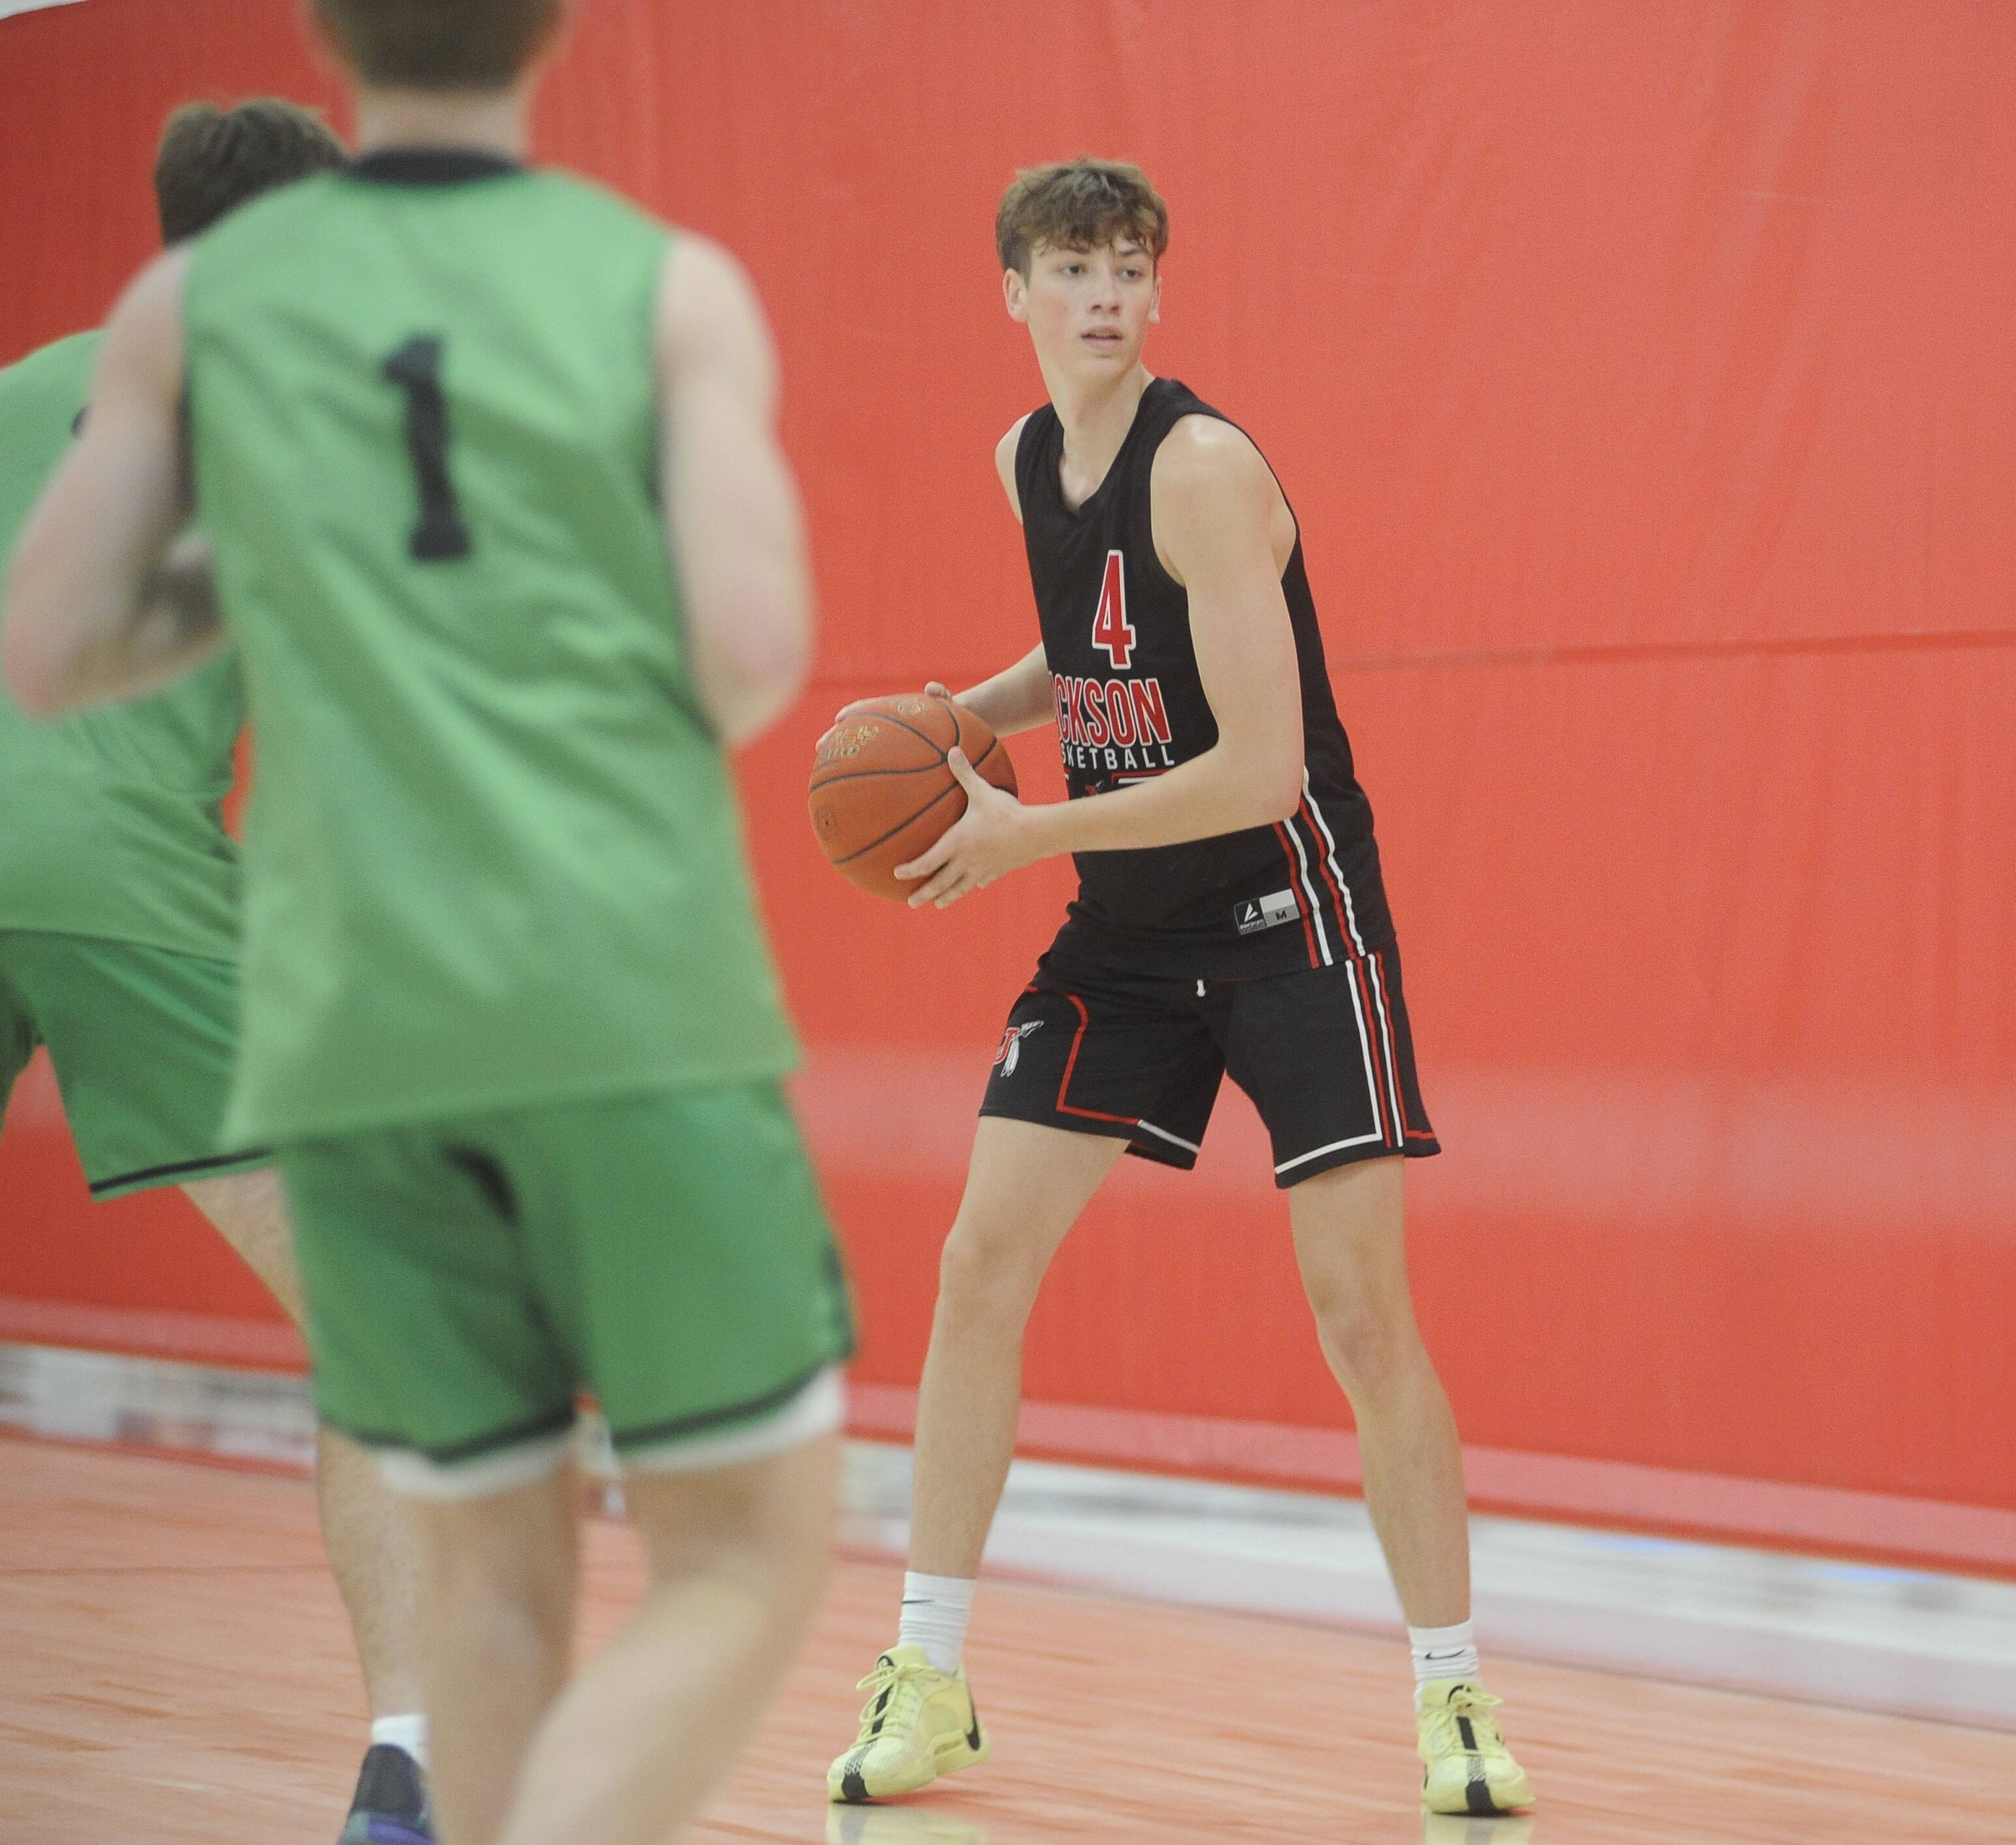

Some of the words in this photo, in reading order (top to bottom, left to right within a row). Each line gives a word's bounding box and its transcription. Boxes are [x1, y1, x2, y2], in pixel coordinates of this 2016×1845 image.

[381, 334, 469, 560] 1
[1092, 550, 1136, 669] 4
[1049, 670, 1172, 749] CKSON
[1275, 909, 1287, 920] M
